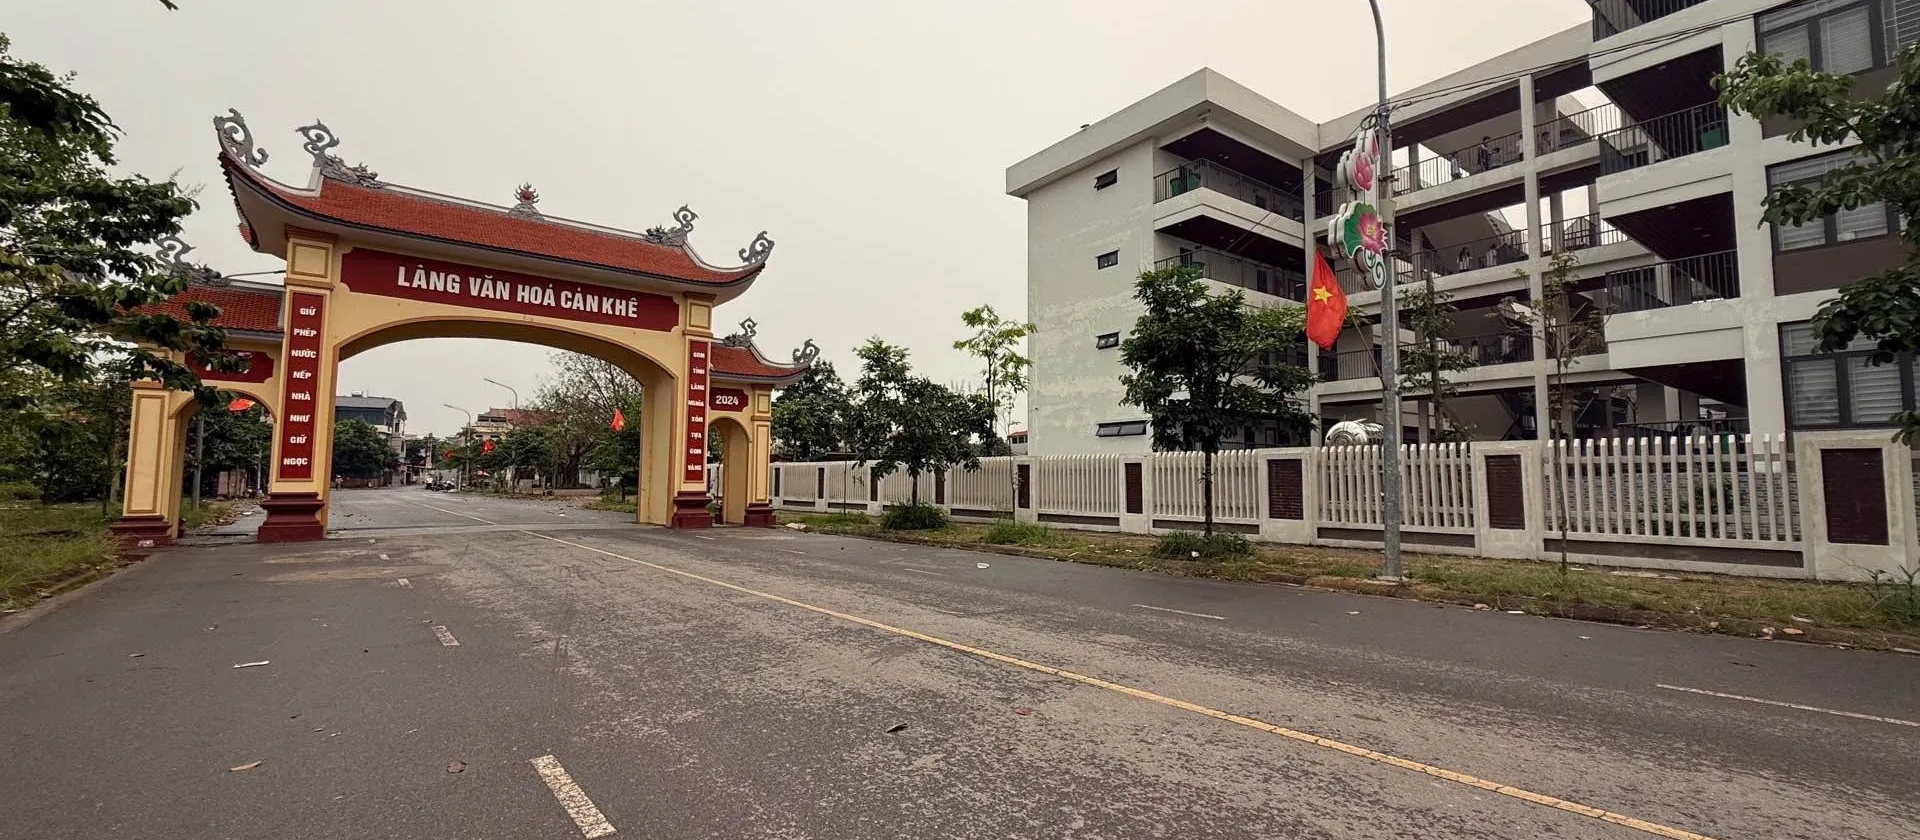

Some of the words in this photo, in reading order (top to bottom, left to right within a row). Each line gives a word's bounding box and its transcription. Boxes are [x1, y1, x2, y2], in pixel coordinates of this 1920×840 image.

[469, 275, 510, 300] VĂN
[517, 284, 556, 307] HOÁ
[561, 287, 598, 313] CÁN
[602, 297, 638, 318] KHÊ
[294, 328, 317, 337] PHÉP
[291, 349, 316, 358] NƯỚC
[293, 370, 311, 379] NẾP
[292, 391, 310, 400] NHÀ
[715, 394, 739, 407] 2024
[290, 414, 310, 422] NHƯ
[283, 458, 308, 467] NGỌC
